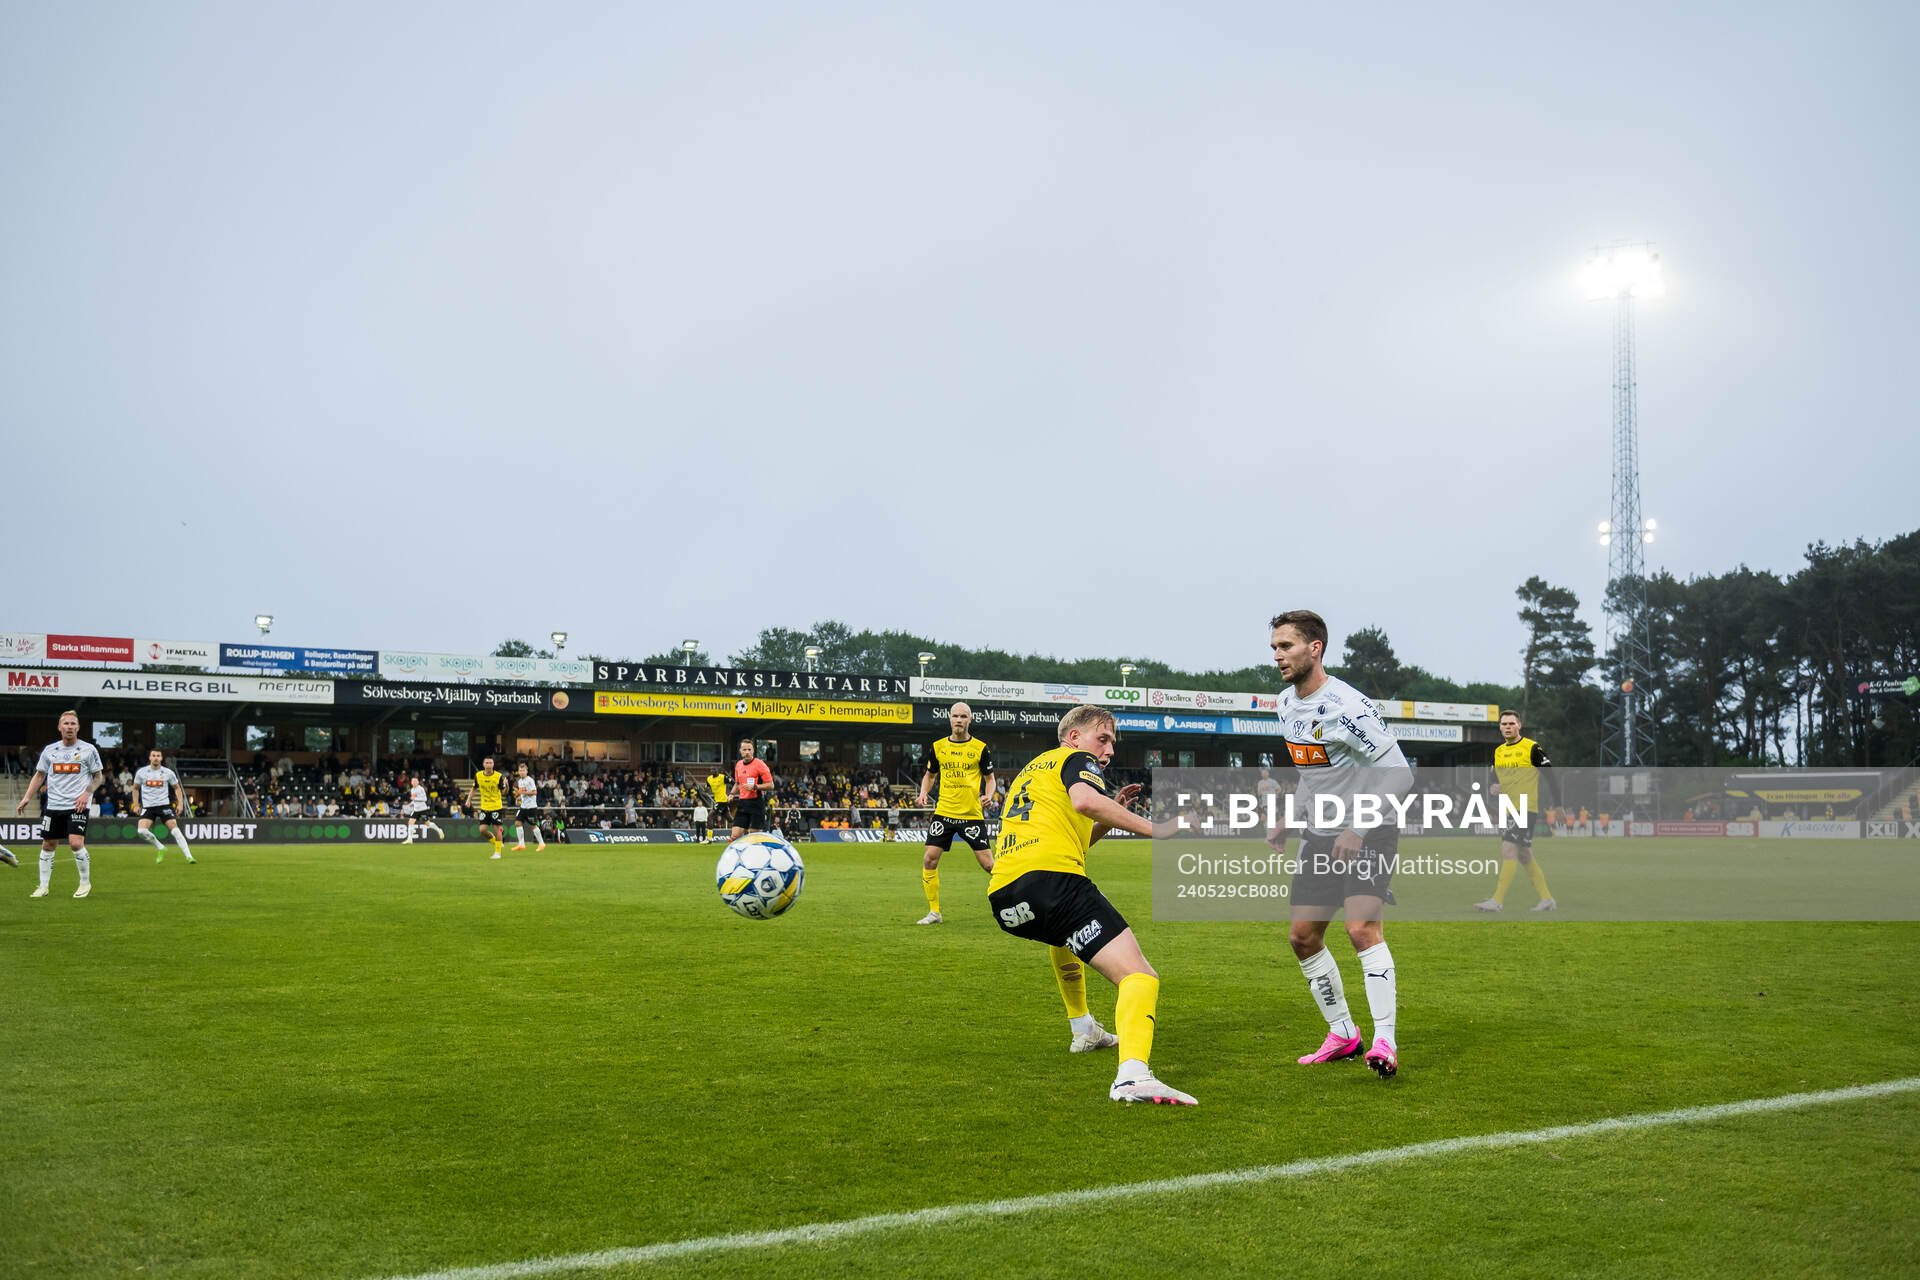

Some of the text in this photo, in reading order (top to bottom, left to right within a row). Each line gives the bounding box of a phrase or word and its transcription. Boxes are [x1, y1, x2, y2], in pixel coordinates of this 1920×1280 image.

[52, 643, 129, 654] Starka tillsammans
[226, 648, 295, 660] ROLLUP-KUNGEN
[8, 671, 59, 688] MAXI
[102, 679, 239, 694] AHLBERG BIL
[258, 681, 331, 693] meritum
[598, 665, 907, 693] SPARBANKSLÄKTAREN
[920, 679, 969, 694] Lönneberga
[362, 684, 542, 705] Sölvesborg-Mjällby Sparbank
[978, 682, 1025, 697] Lönneberga
[1105, 689, 1140, 703] coop
[611, 694, 732, 712] Sölvesborgs kommun
[751, 701, 793, 715] Mjällby
[829, 705, 894, 718] hemmaplan
[932, 707, 1060, 724] Sölvrg-Mjällby Sparbank
[1174, 720, 1217, 730] LARSSON
[1339, 714, 1377, 753] stadium
[1006, 778, 1036, 822] 4
[0, 824, 44, 840] NIBE
[185, 824, 257, 840] UNIBET
[364, 824, 429, 839] UNIBET
[1399, 823, 1425, 835] NIBET
[1066, 919, 1103, 955] XTRA
